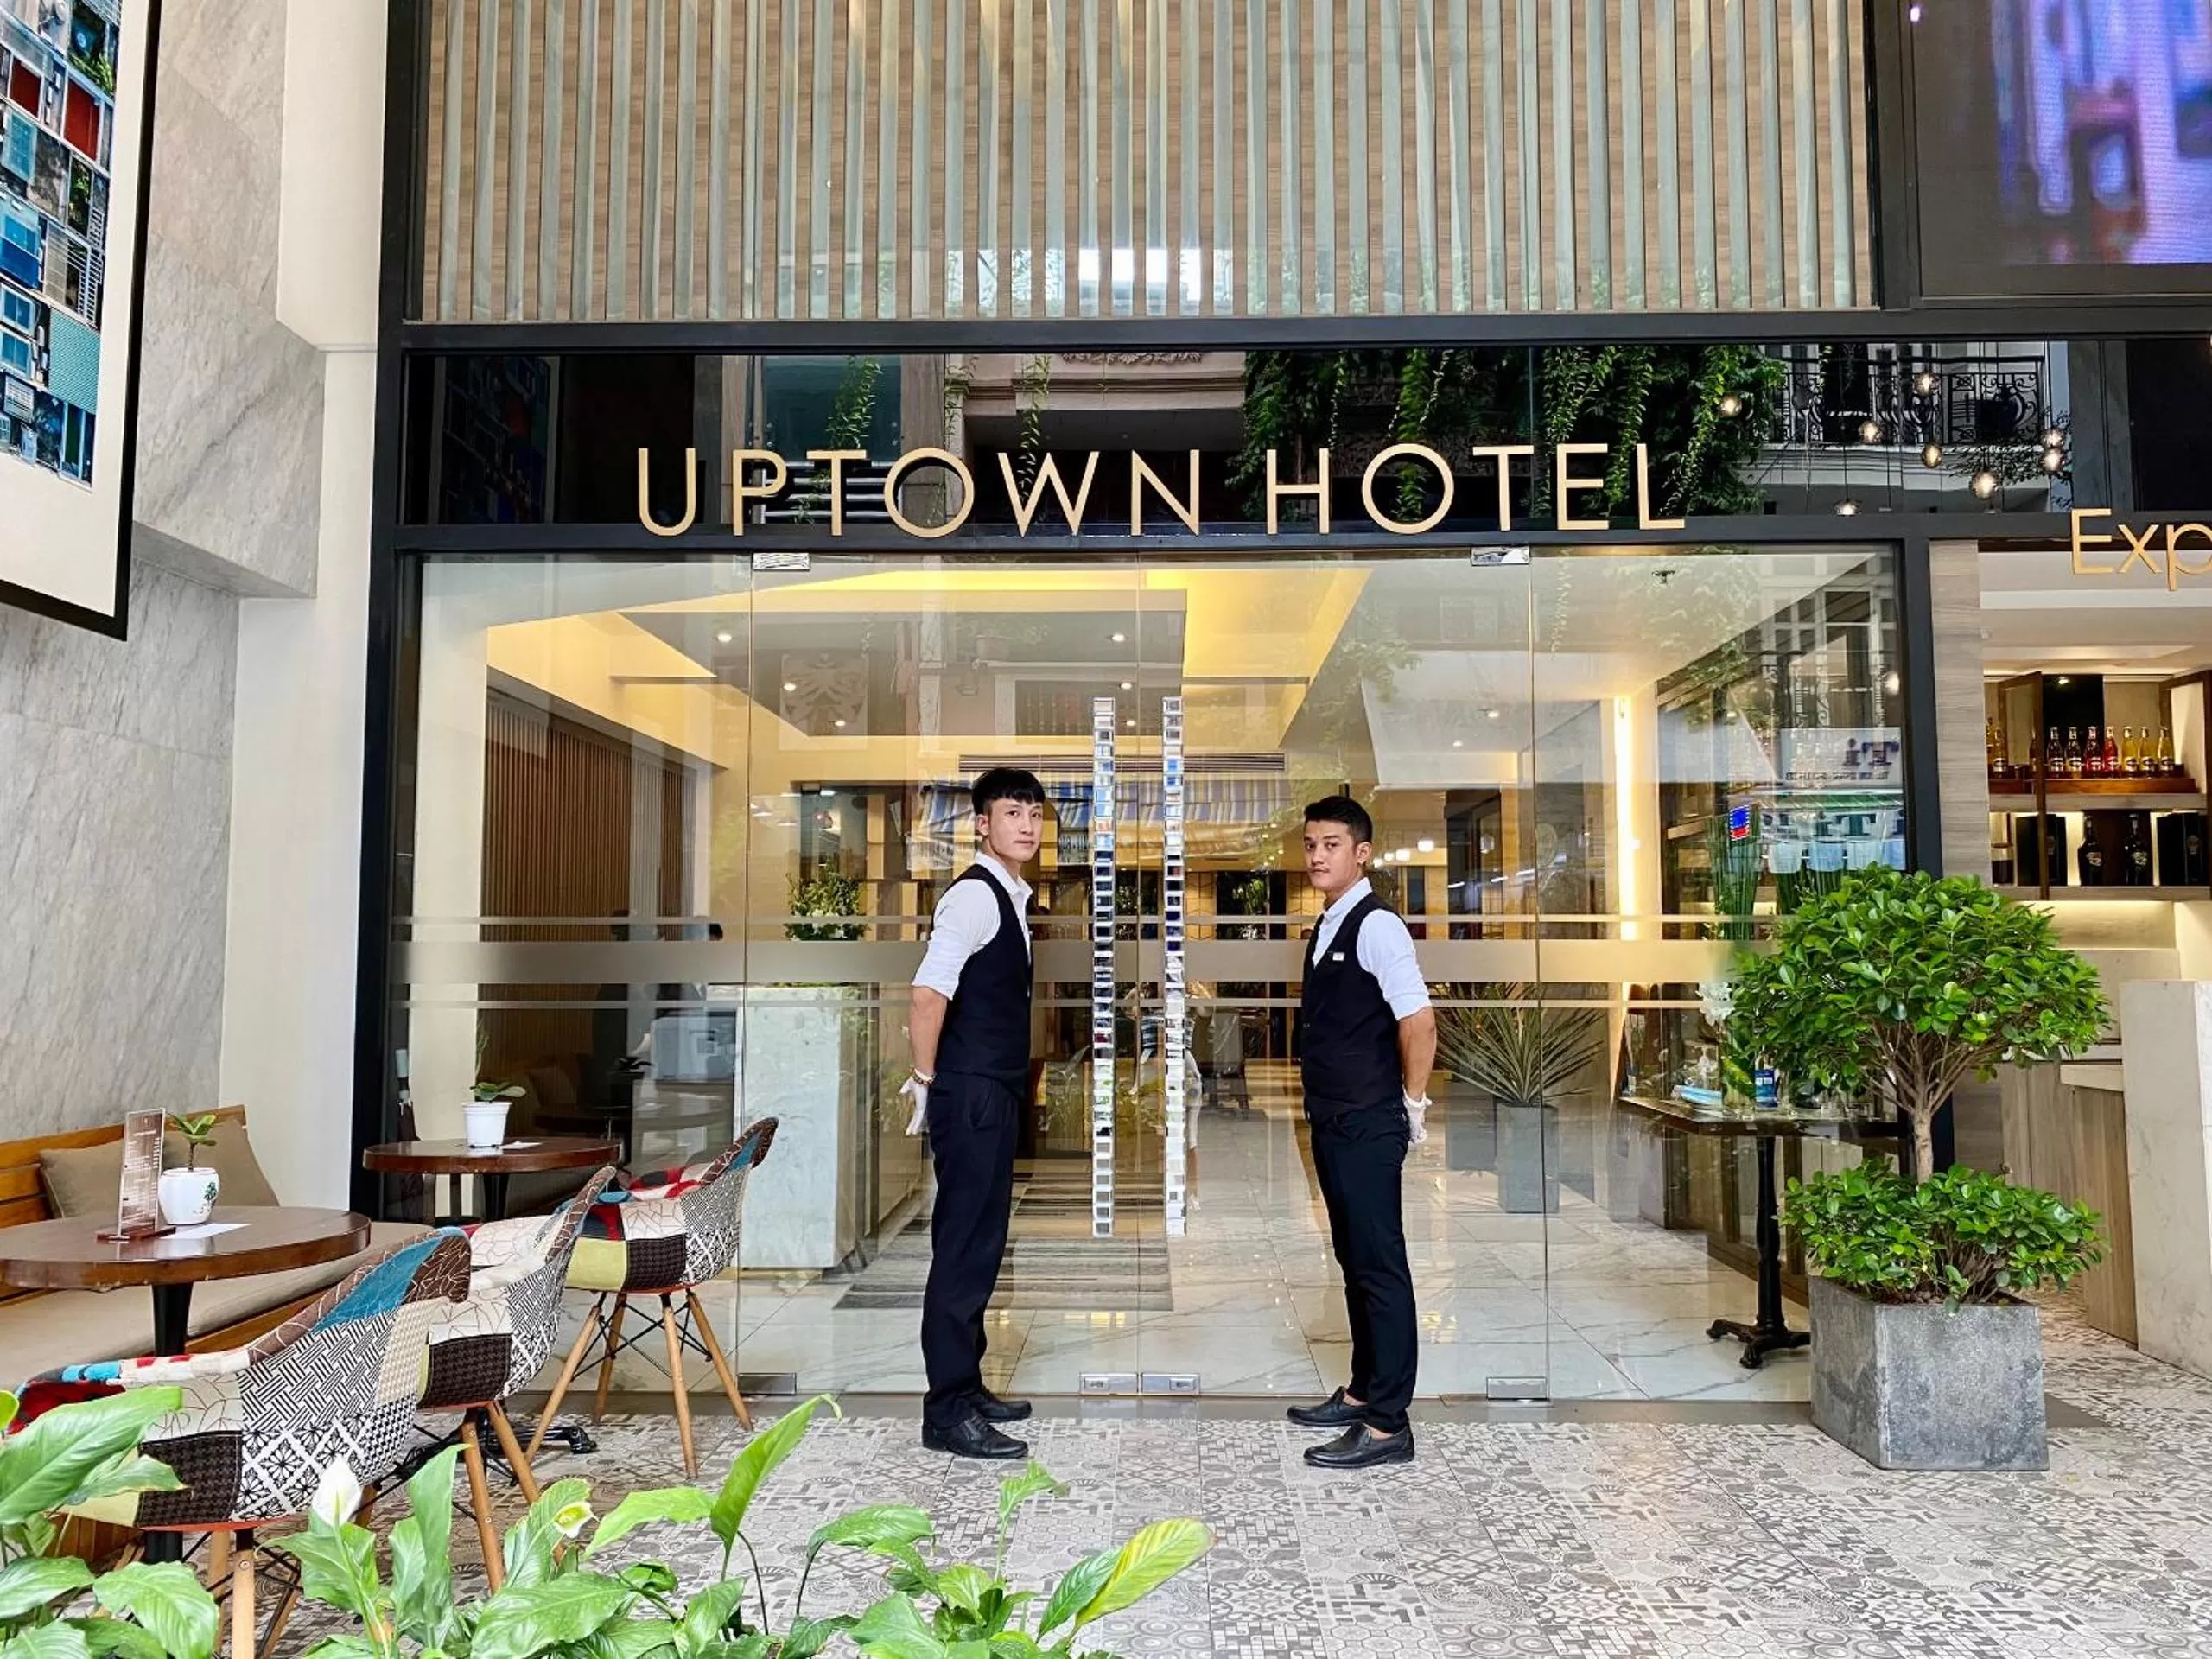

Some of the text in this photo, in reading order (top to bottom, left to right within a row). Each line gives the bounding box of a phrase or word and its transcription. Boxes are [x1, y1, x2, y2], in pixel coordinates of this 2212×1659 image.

[638, 443, 1685, 537] UPTOWN HOTEL
[2071, 508, 2212, 591] Exp
